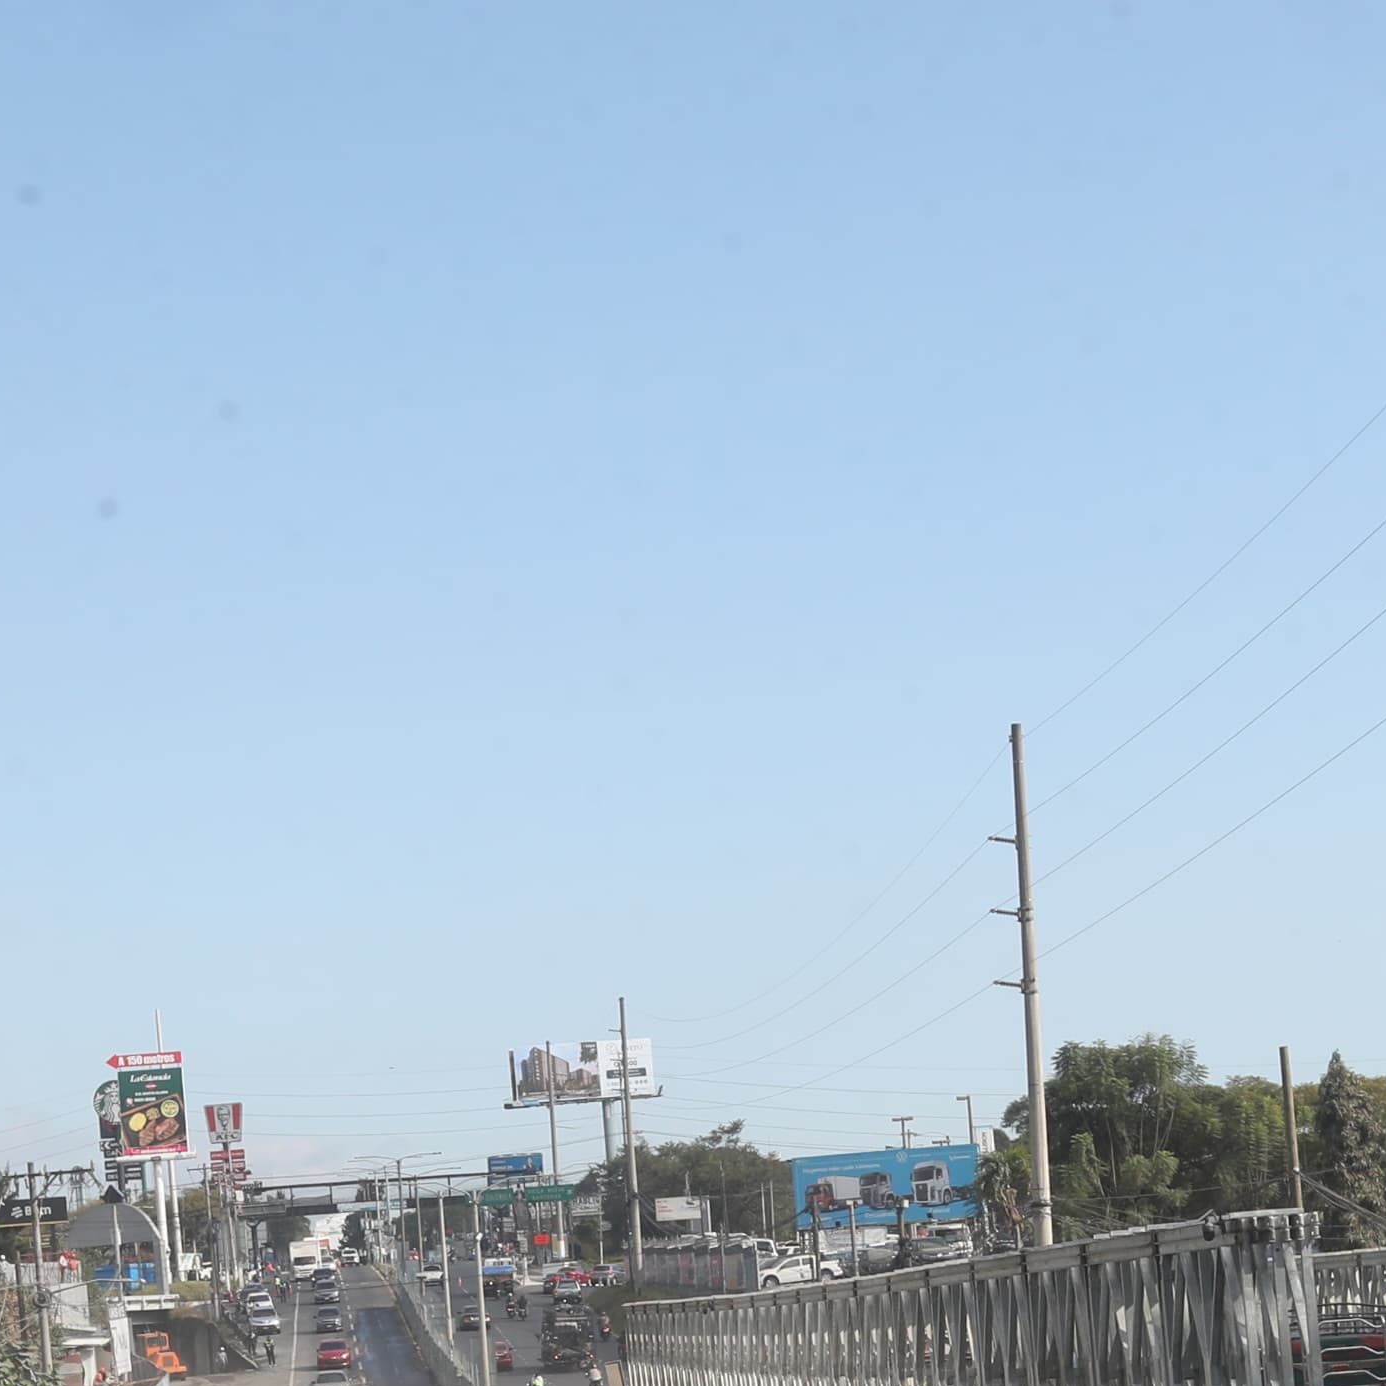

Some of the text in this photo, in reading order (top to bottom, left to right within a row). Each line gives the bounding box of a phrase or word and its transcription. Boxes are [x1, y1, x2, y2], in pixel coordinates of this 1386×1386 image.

[117, 1053, 175, 1066] A 150 metros
